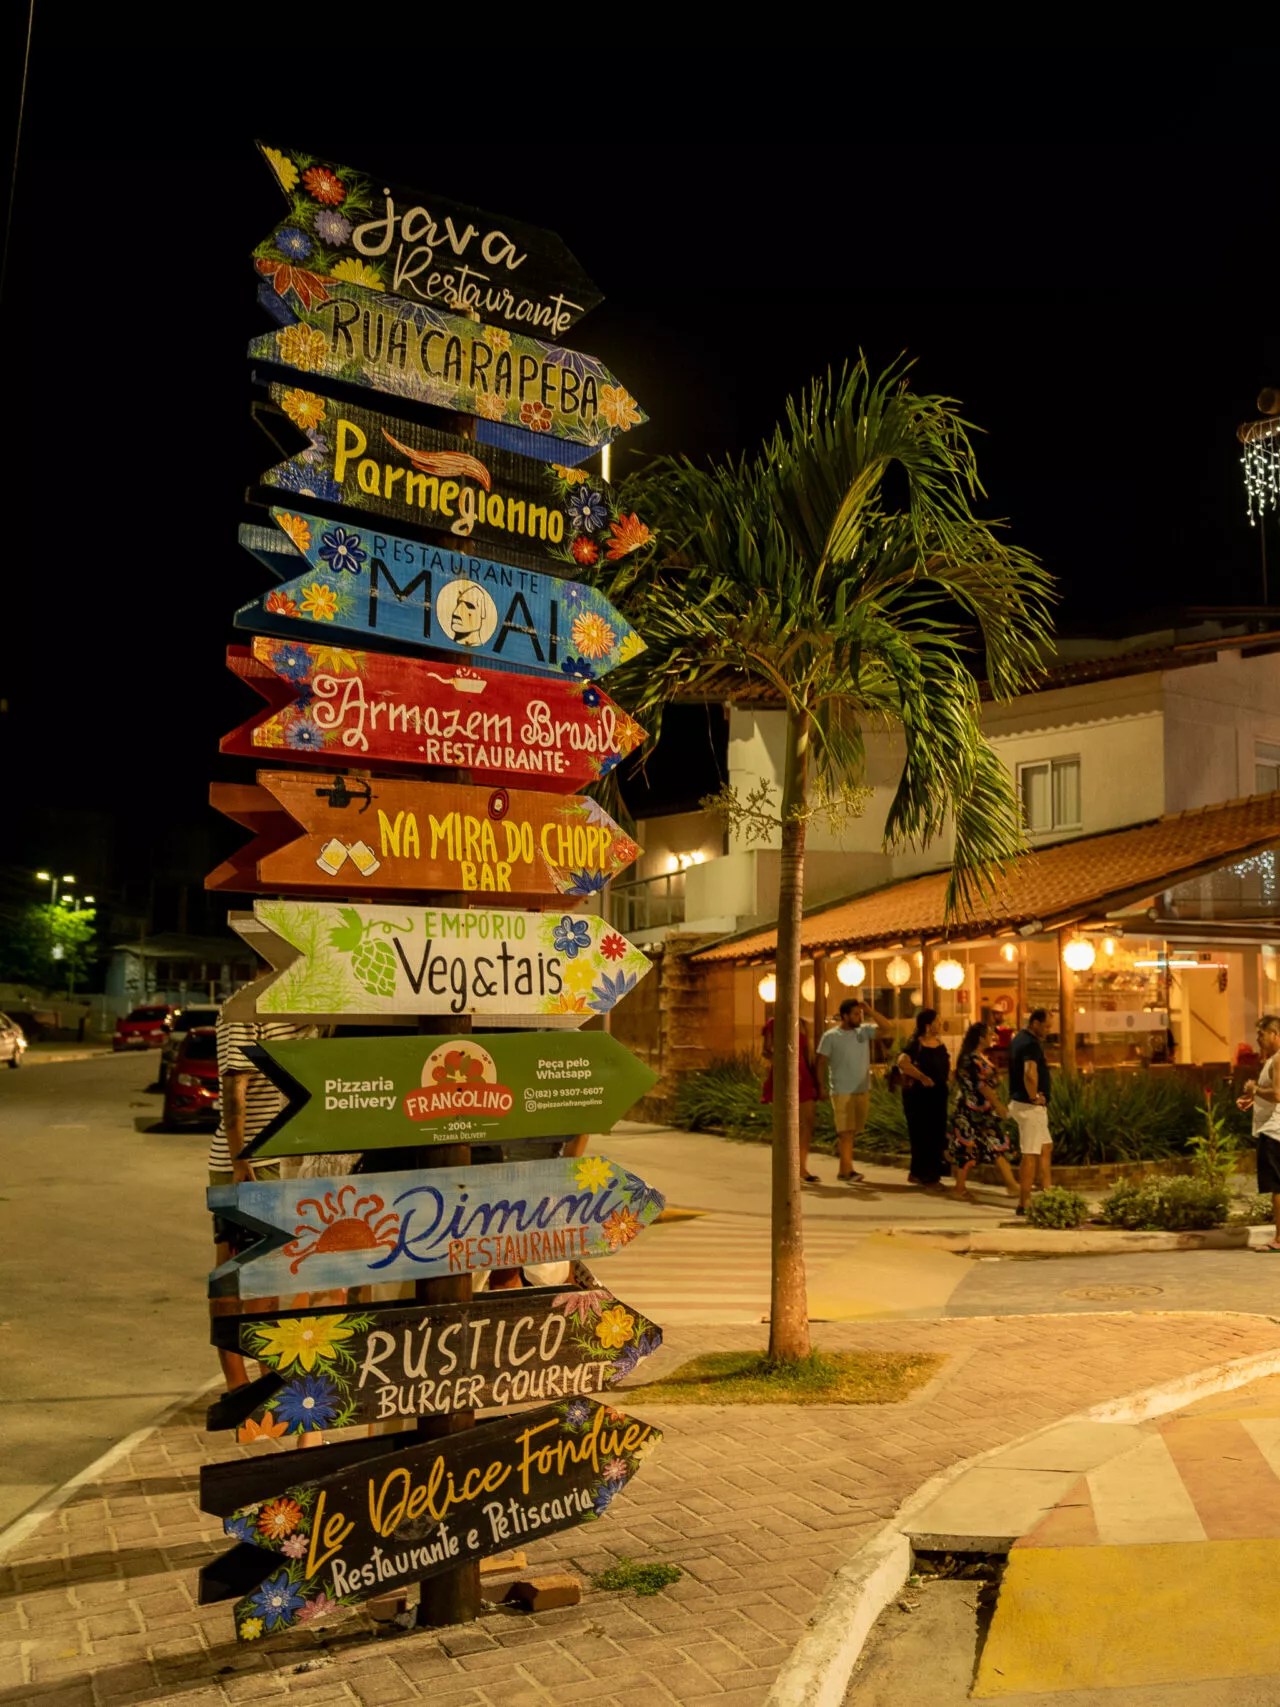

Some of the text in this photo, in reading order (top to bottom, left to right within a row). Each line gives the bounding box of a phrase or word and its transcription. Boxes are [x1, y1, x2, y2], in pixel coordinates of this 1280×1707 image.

[352, 187, 527, 270] java
[392, 243, 584, 331] Restaurante
[315, 298, 599, 418] RUA CARAPEBA
[334, 418, 565, 543] Parmegianno
[373, 535, 541, 594] RESTAURANTE
[368, 556, 558, 665] MOAI
[311, 674, 621, 753] Armazem Brasil
[426, 738, 565, 774] RESTAURANTE
[377, 809, 612, 870] NA MIRA DO CHOPP
[460, 861, 512, 892] BAR
[425, 911, 526, 940] EMPÓRIO
[392, 936, 563, 1014] Veg&tais
[325, 1076, 394, 1093] Pizzaria
[535, 1069, 592, 1080] Whatsapp
[538, 1057, 590, 1071] Peça pelo
[552, 1089, 559, 1097] 9
[325, 1093, 397, 1110] Delivery
[406, 1090, 513, 1117] FRANGOLINO
[448, 1121, 472, 1131] 2004
[367, 1178, 624, 1270] Rimini
[448, 1225, 591, 1273] RESTAURANTE
[358, 1312, 567, 1389] RÚSTICO
[375, 1360, 612, 1420] BURGER GOURMET
[305, 1404, 651, 1581] Le Delice Fondue
[330, 1486, 595, 1598] Restaurante e Petiscaria
